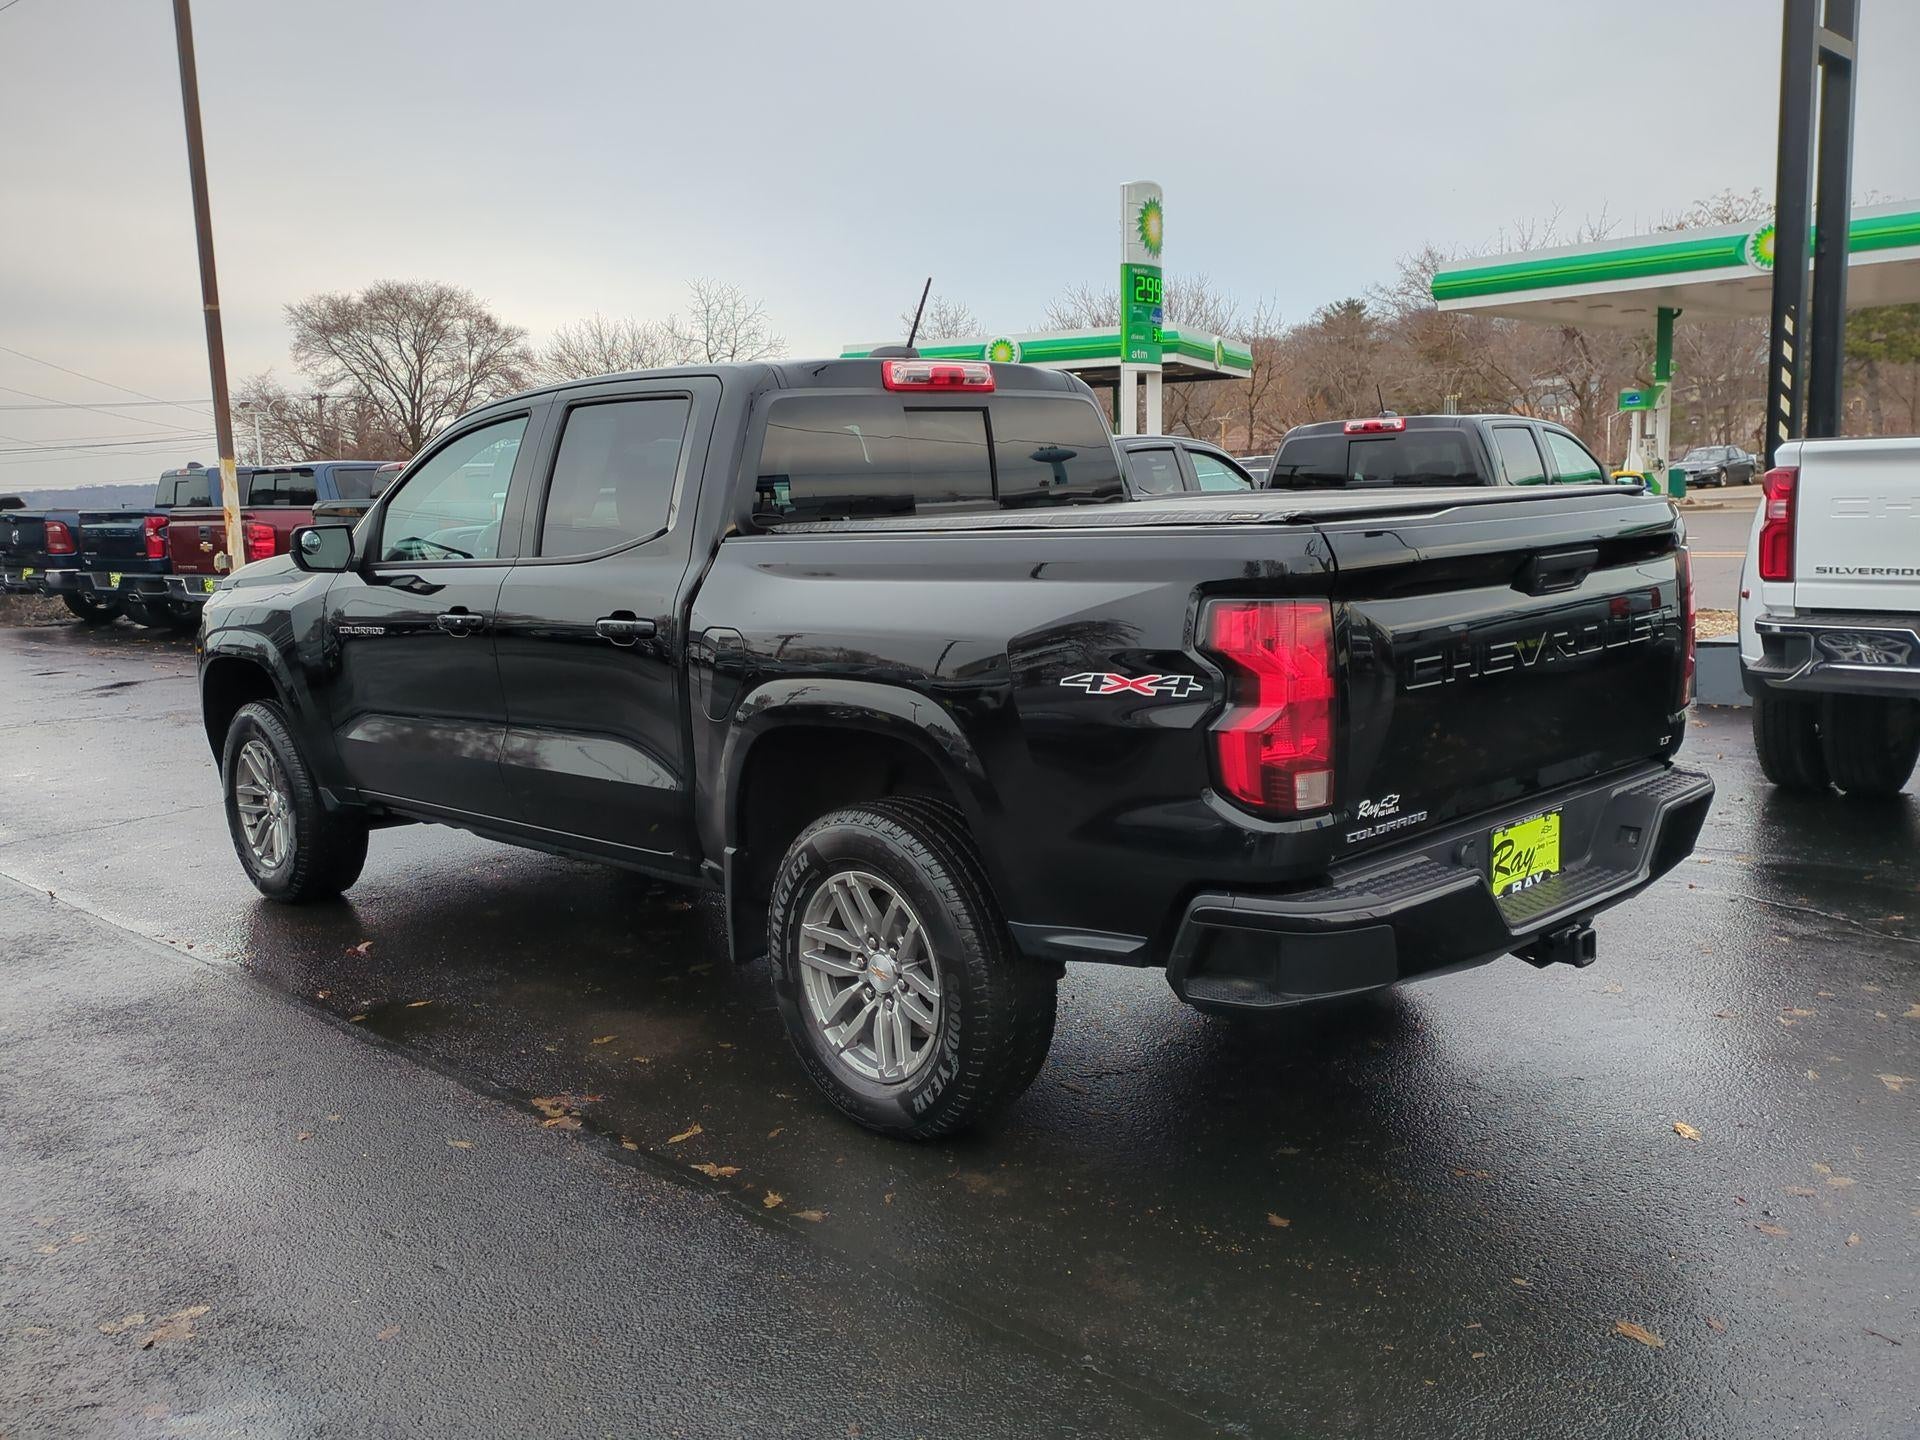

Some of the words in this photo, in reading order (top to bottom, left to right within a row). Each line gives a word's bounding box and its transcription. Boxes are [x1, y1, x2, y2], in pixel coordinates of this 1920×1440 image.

[1131, 349, 1148, 359] atm
[339, 626, 385, 635] COLORADO
[1405, 605, 1673, 690] CHEVROLET
[1659, 735, 1673, 746] LT
[1357, 799, 1381, 820] Ray
[1345, 810, 1428, 844] COLORADO
[1492, 838, 1536, 882] Ray
[770, 850, 811, 980] WRANGLER
